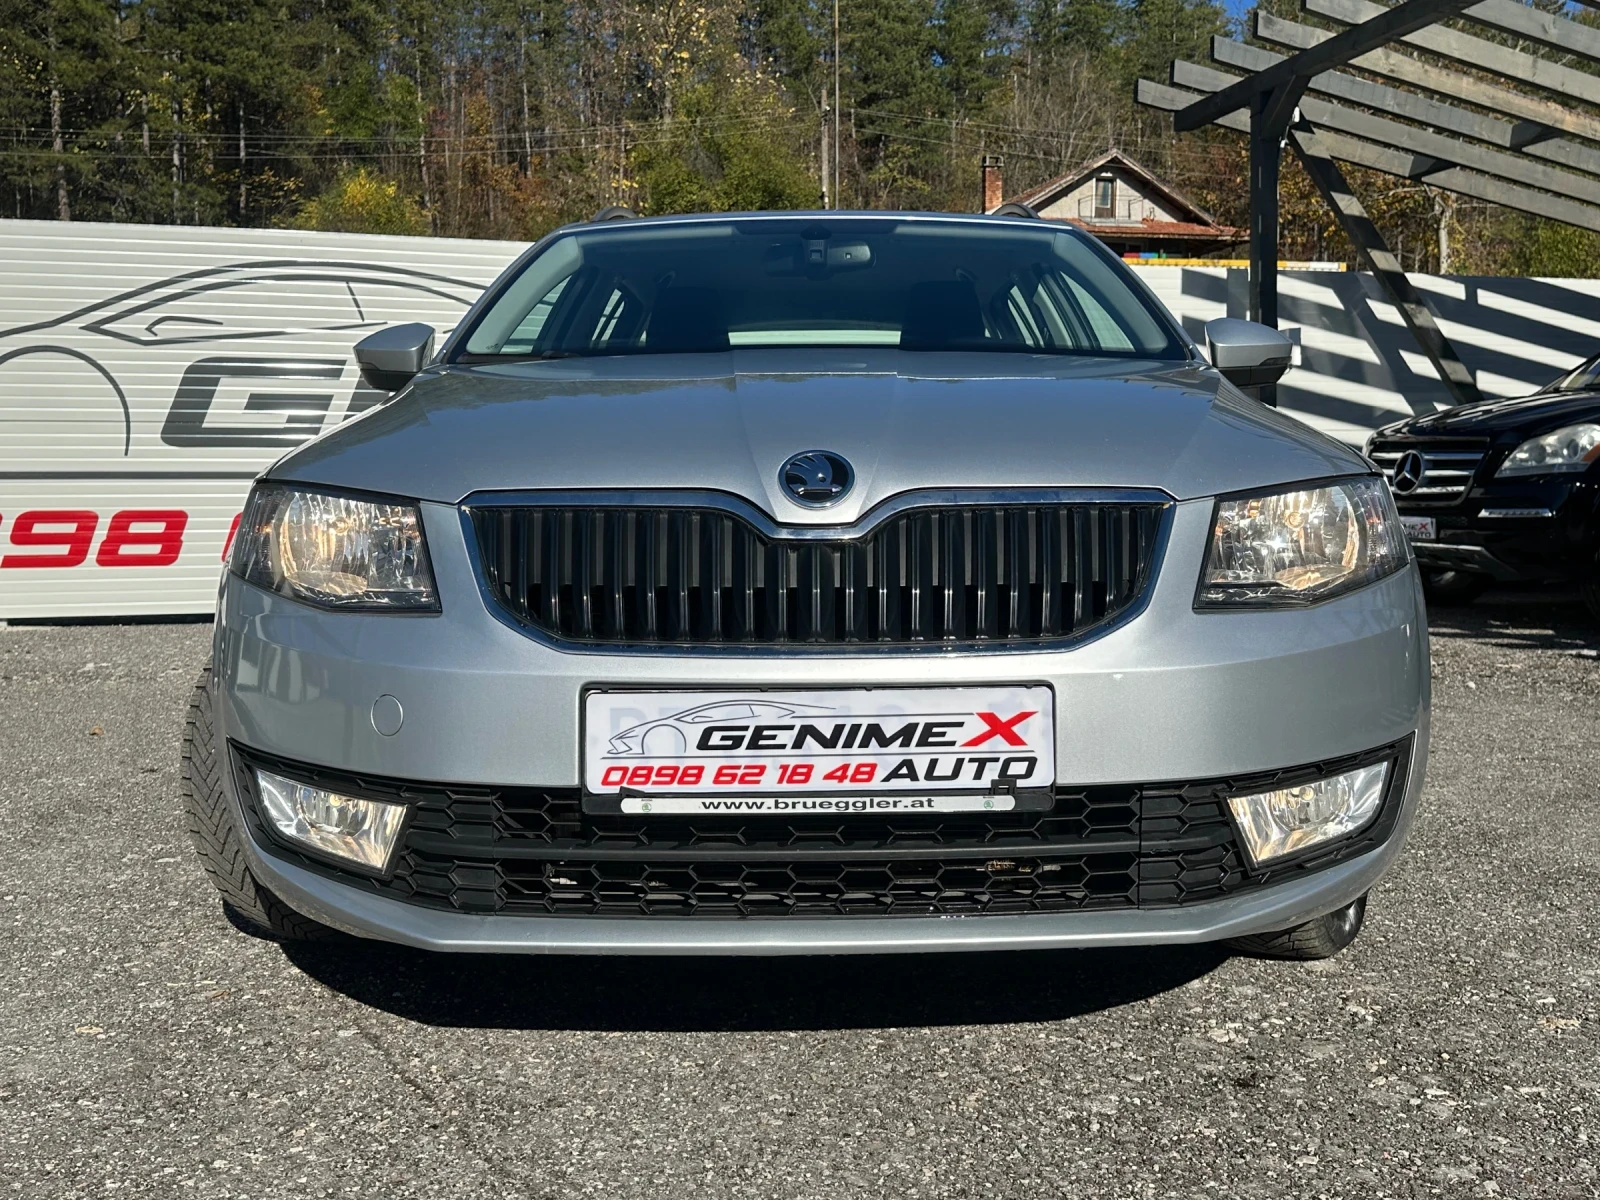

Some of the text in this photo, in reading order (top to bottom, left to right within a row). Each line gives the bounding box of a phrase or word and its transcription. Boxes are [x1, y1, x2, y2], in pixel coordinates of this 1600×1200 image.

[160, 357, 398, 447] G
[0, 510, 188, 568] 98
[696, 711, 1039, 751] GENIMEX
[601, 763, 878, 786] 0898 62 18 48
[880, 756, 1038, 783] AUTO
[701, 797, 935, 811] www.brueggler.at
